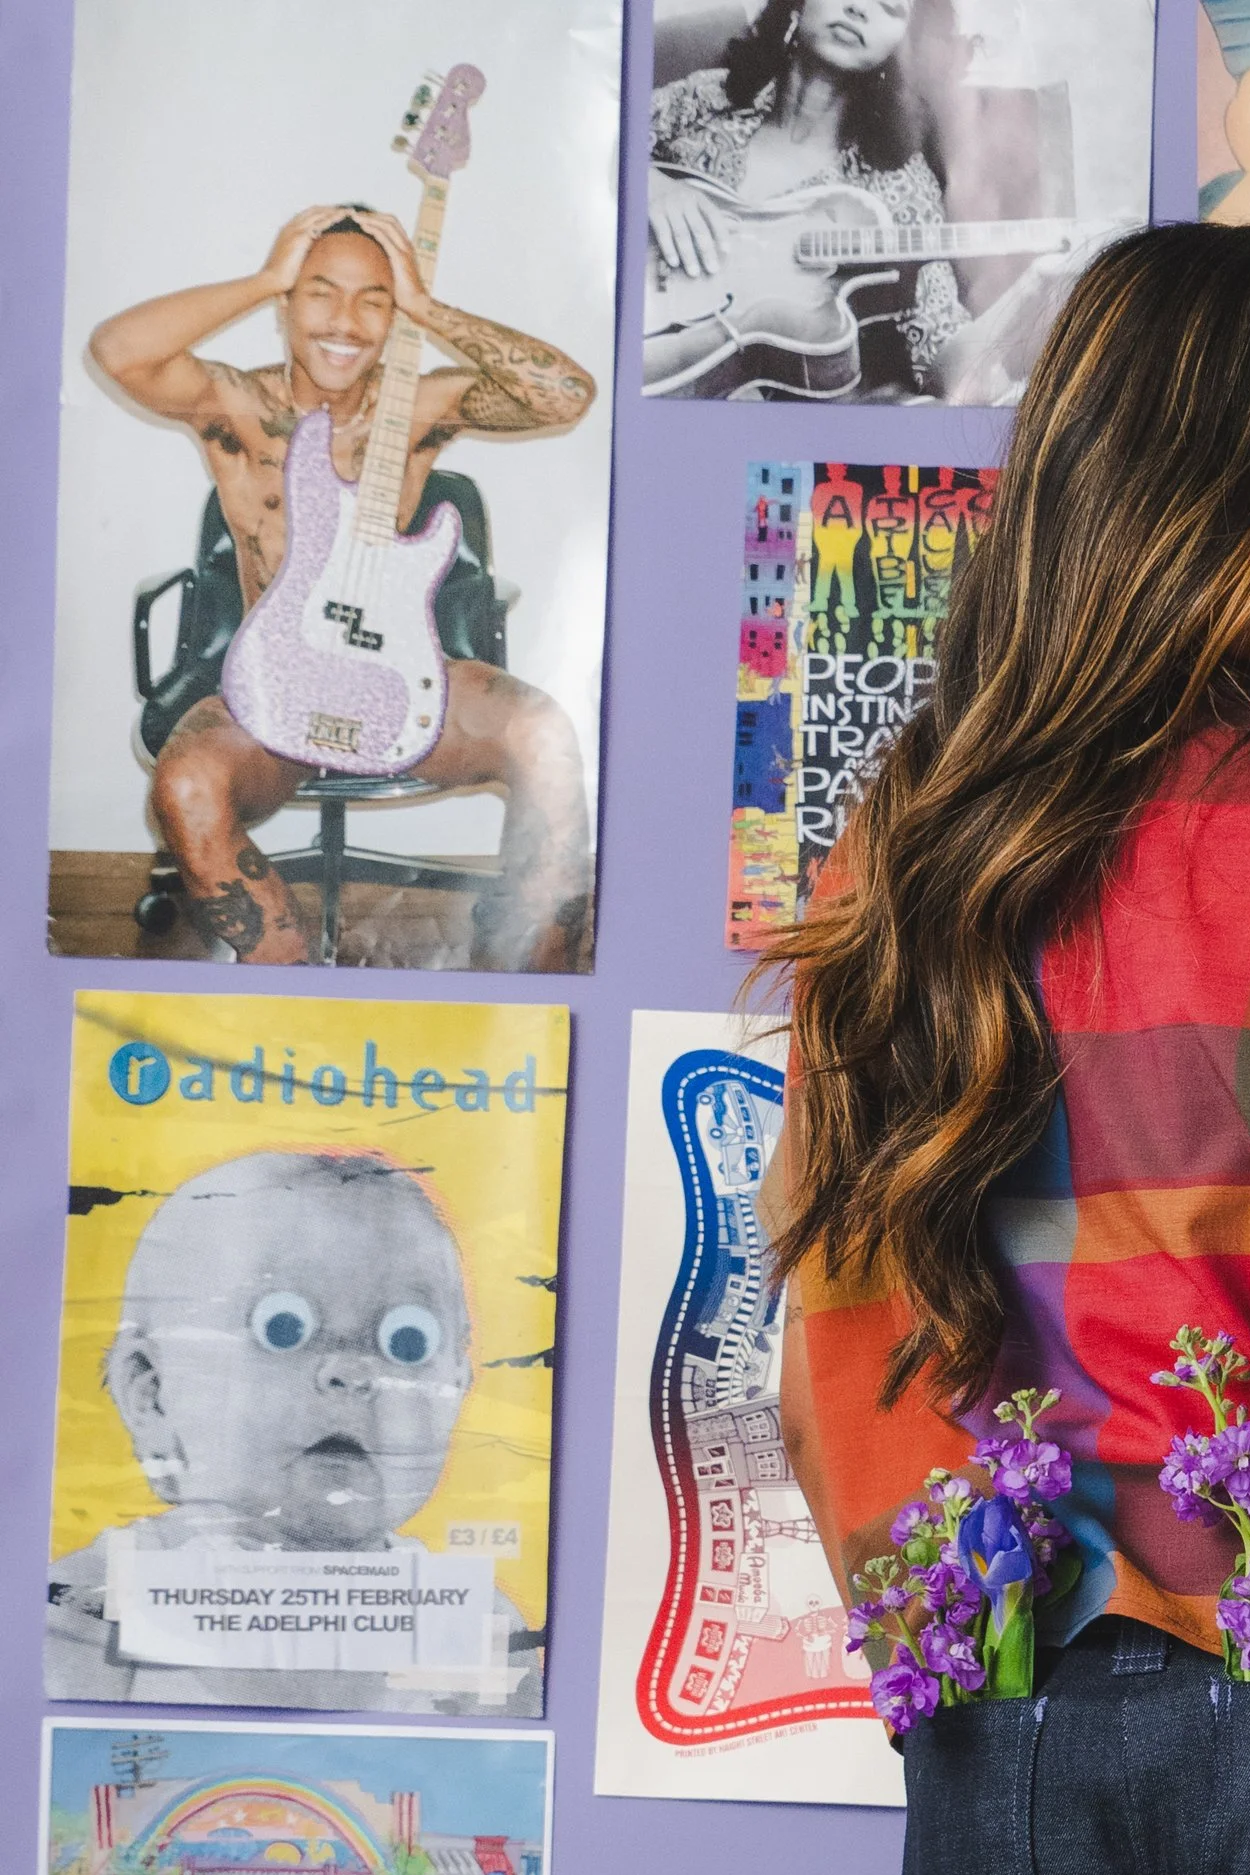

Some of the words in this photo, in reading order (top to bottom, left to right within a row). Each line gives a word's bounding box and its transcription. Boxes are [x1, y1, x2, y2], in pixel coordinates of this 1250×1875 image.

[821, 495, 854, 529] A
[802, 653, 941, 698] PEOP
[109, 1041, 537, 1114] radiohead
[323, 1565, 400, 1576] SPACEMAID
[149, 1587, 277, 1607] THURSDAY
[282, 1588, 340, 1606] 25TH
[347, 1588, 469, 1607] FEBRUARY
[194, 1615, 243, 1632] THE
[248, 1615, 346, 1633] ADELPHI
[353, 1615, 415, 1633] CLUB
